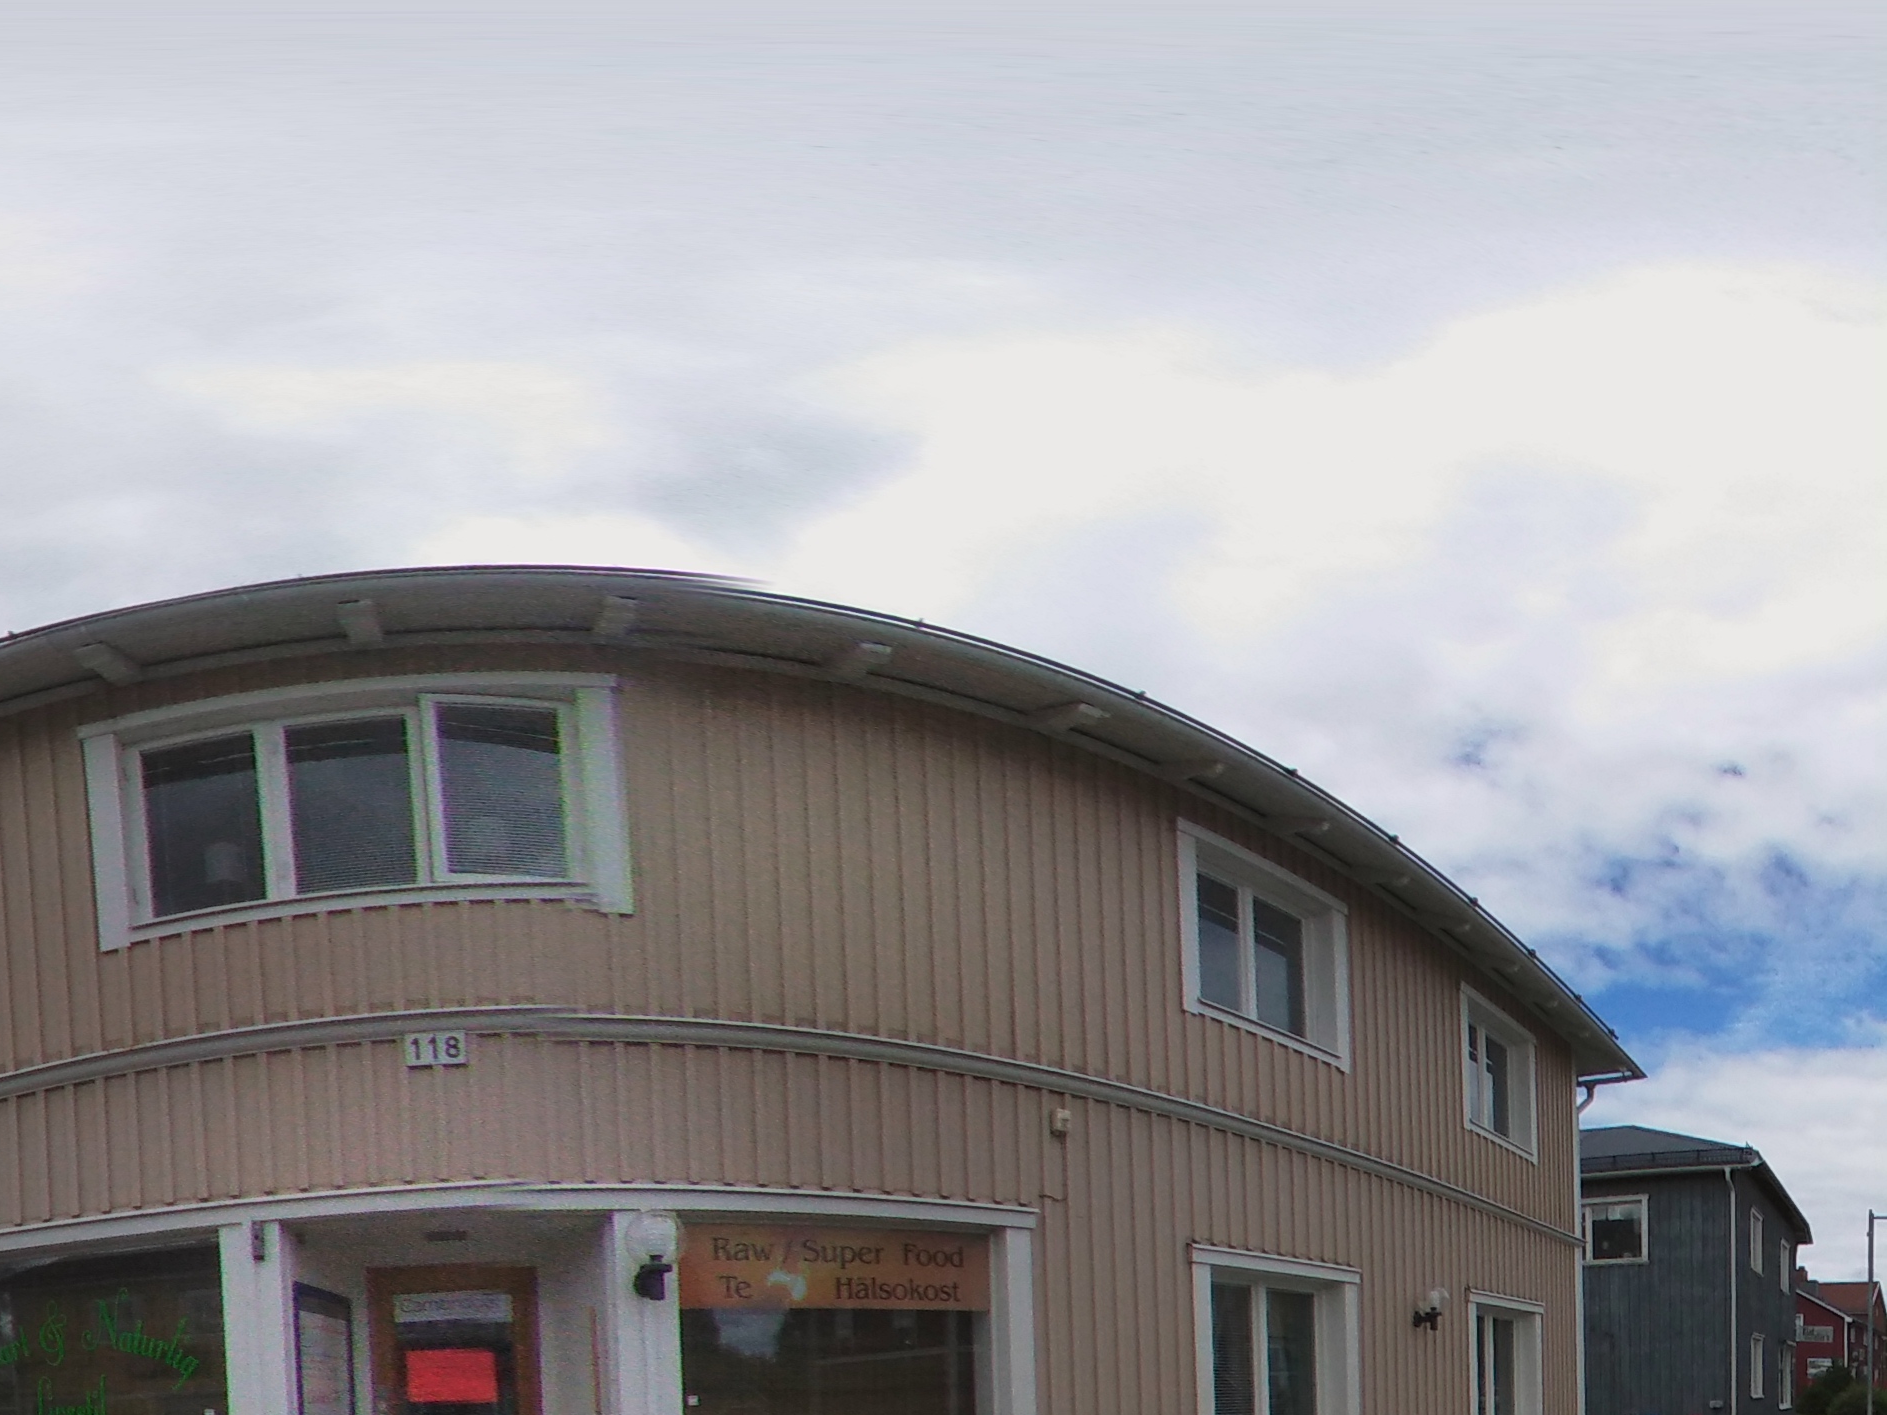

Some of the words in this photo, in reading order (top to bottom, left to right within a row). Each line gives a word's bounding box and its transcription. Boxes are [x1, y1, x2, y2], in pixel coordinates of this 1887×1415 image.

[410, 1034, 461, 1061] 118
[712, 1237, 774, 1262] Raw
[802, 1239, 885, 1269] Super
[903, 1243, 965, 1268] Food
[719, 1275, 753, 1299] Te
[834, 1276, 962, 1302] Hälsokost
[39, 1300, 67, 1367] &
[81, 1287, 201, 1390] Naturlig
